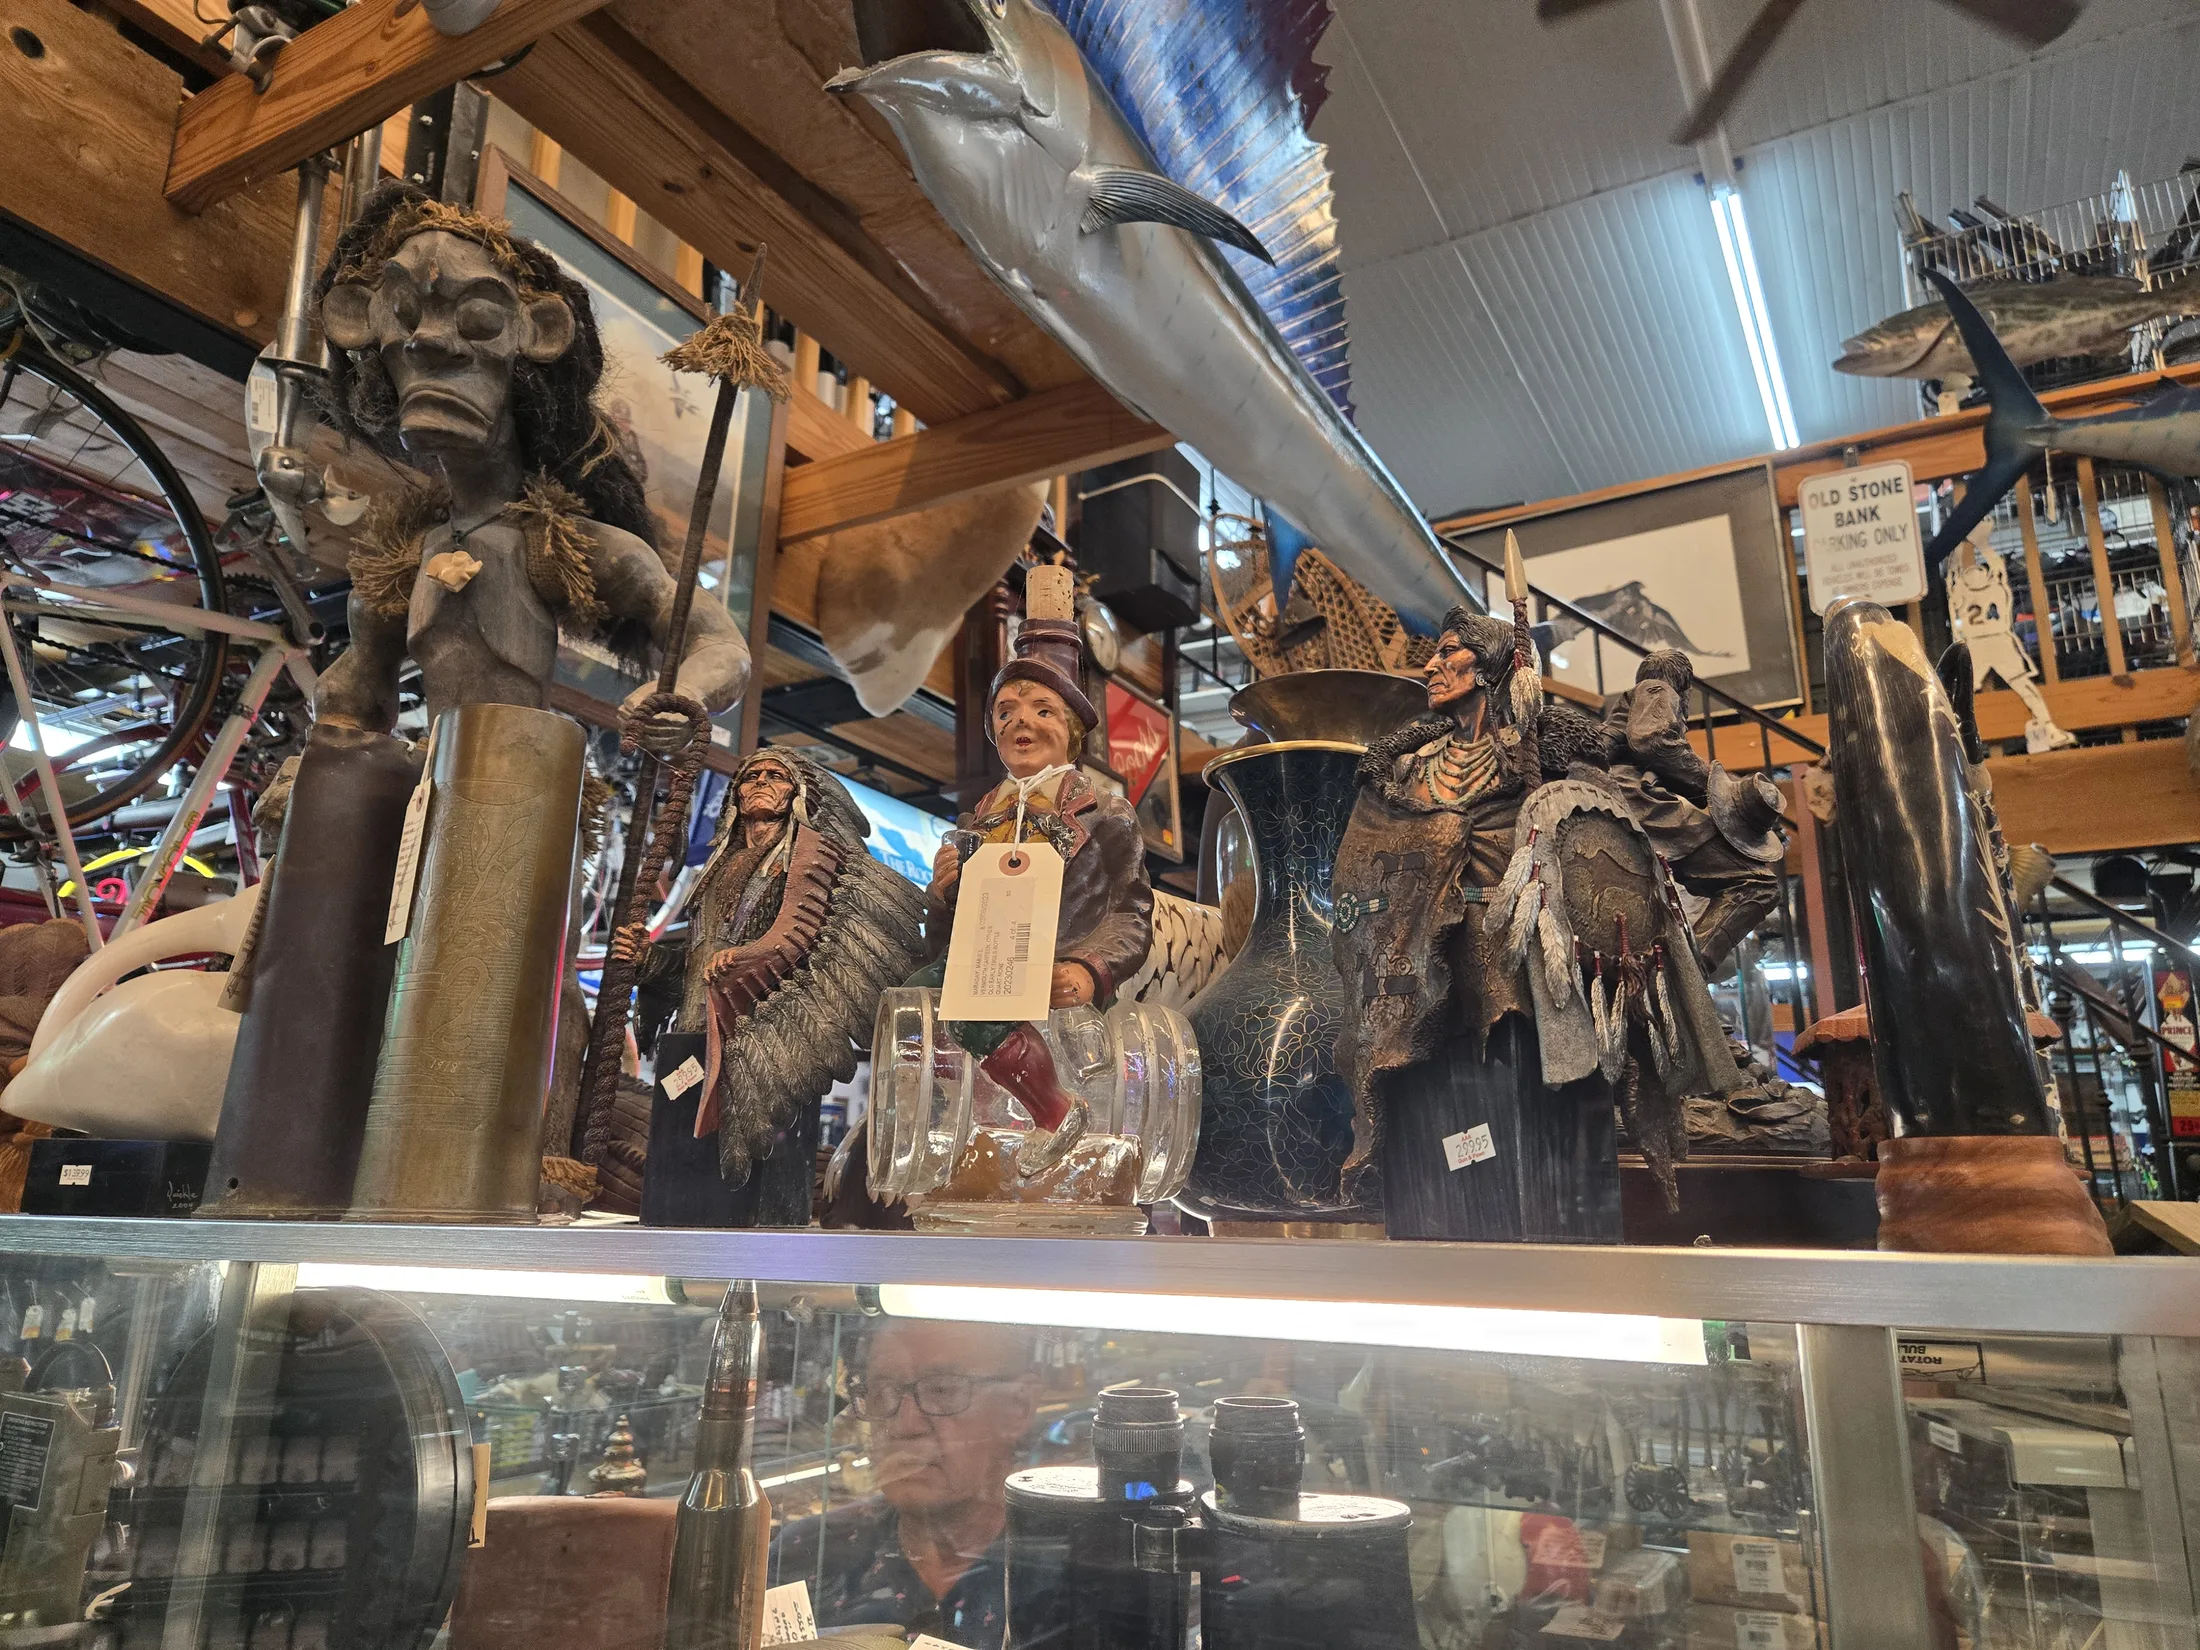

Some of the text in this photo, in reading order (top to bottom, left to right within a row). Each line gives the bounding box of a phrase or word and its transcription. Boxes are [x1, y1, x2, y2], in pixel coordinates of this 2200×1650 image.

[1808, 477, 1904, 510] OLD STONE
[1835, 504, 1881, 528] BANK
[1812, 523, 1909, 553] RKING ONLY
[1966, 602, 2001, 626] 24
[1003, 956, 1015, 995] 20230246
[2161, 1026, 2193, 1035] PRINCE
[430, 1059, 459, 1074] 1918
[1455, 1133, 1490, 1158] 299.95
[1897, 1355, 1943, 1365] ROTAT
